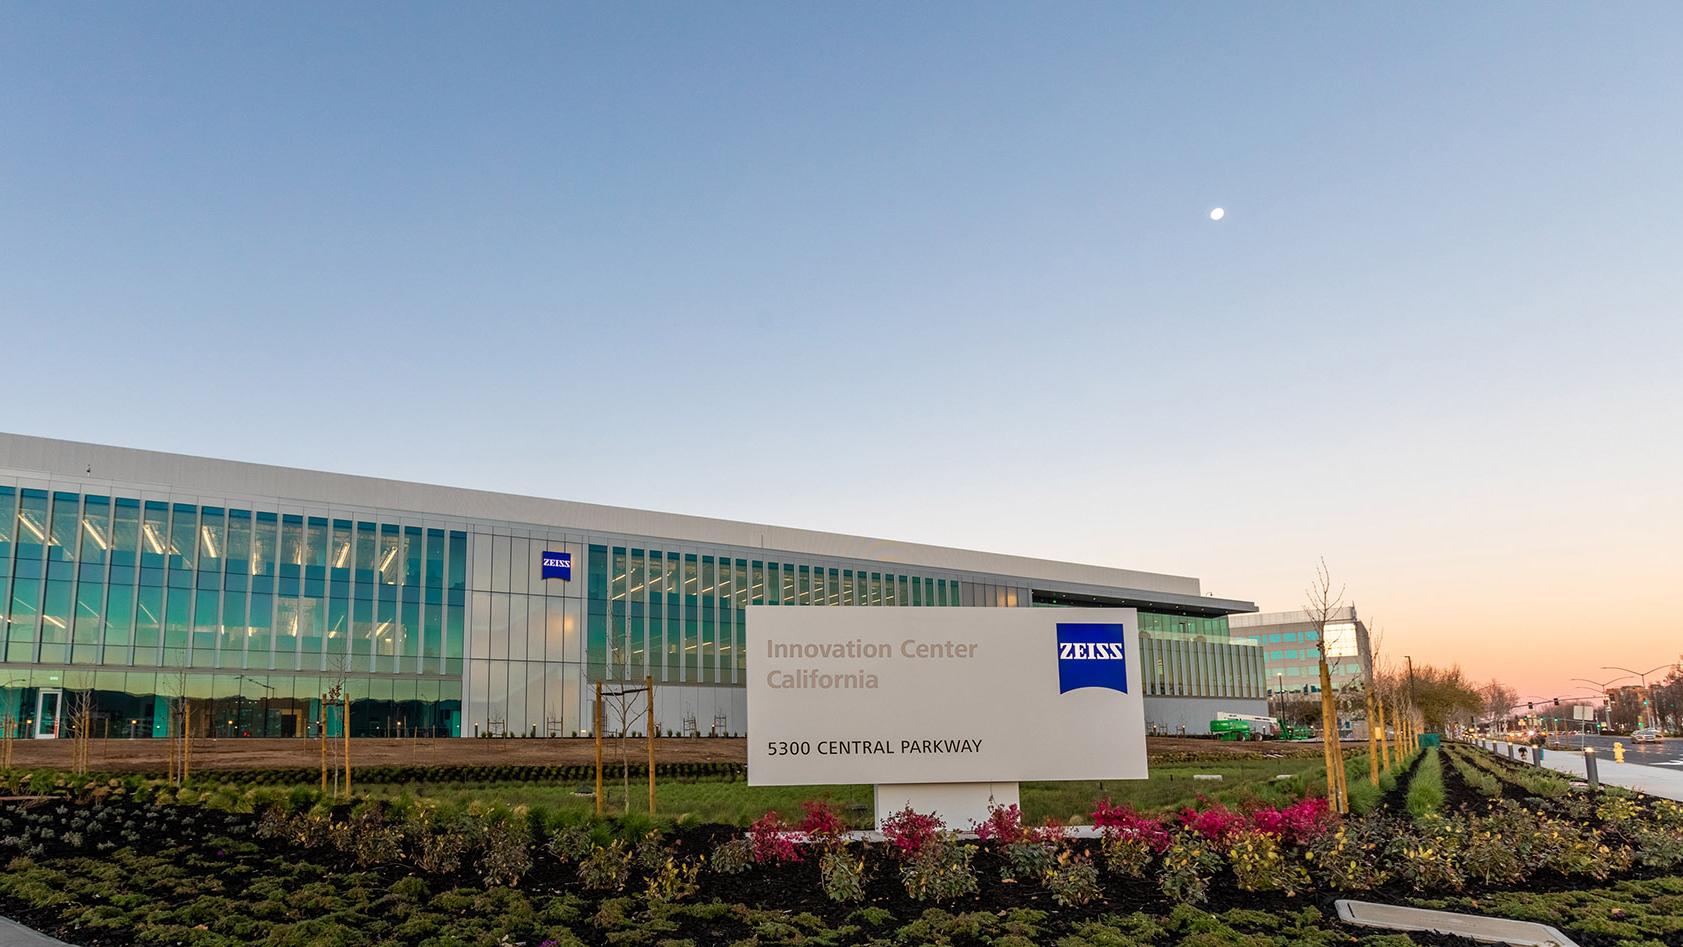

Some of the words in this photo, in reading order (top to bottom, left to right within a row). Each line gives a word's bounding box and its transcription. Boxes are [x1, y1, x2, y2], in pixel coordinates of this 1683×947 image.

[543, 558, 571, 568] ZEISS
[767, 638, 891, 659] Innovation
[901, 639, 979, 659] Center
[1059, 642, 1124, 661] ZEISS
[766, 668, 879, 690] California
[768, 741, 811, 756] 5300
[817, 740, 895, 755] CENTRAL
[901, 738, 983, 754] PARKWAY
